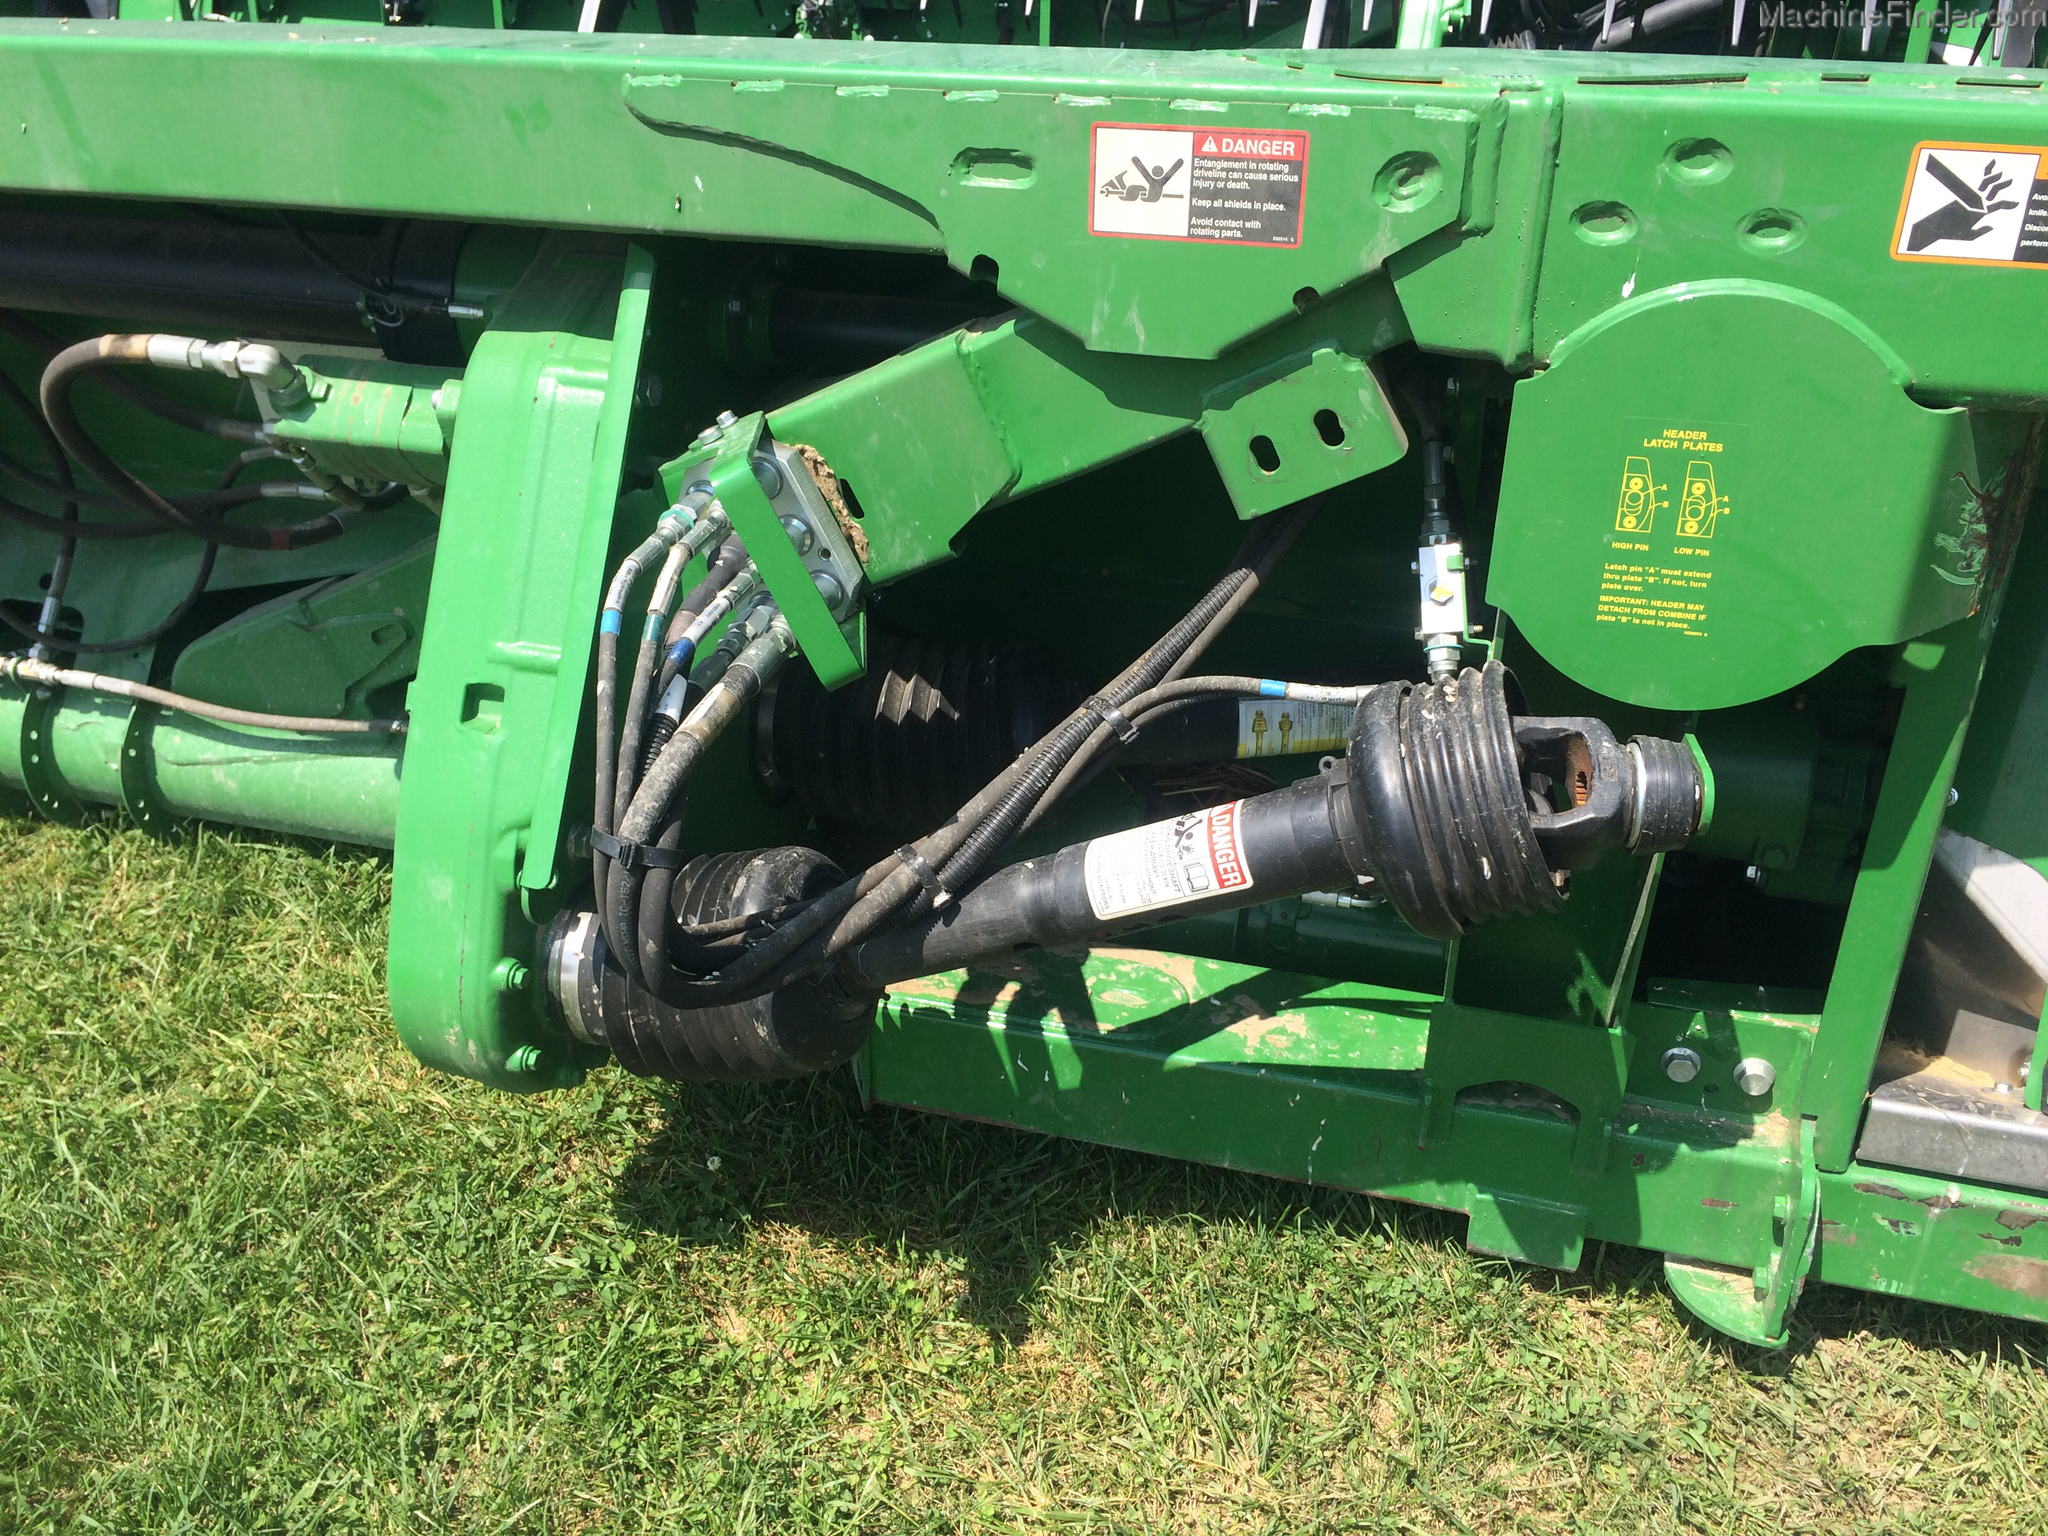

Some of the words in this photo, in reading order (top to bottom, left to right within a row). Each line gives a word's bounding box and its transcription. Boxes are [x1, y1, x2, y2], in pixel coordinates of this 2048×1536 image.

[1222, 138, 1295, 156] DANGER
[1194, 158, 1247, 169] Entanglement
[1249, 161, 1257, 169] in
[1258, 162, 1289, 172] rotating
[1193, 168, 1226, 178] driveline
[1228, 171, 1243, 179] can
[1244, 172, 1267, 180] cause
[1269, 173, 1298, 182] serious
[1193, 179, 1214, 189] injury
[1226, 180, 1250, 189] death.
[2031, 193, 2048, 201] Avo
[1192, 198, 1212, 208] Keep
[1213, 199, 1222, 207] all
[1224, 199, 1252, 209] shields
[1263, 202, 1286, 212] place.
[1191, 217, 1212, 226] Avoid
[1214, 219, 1243, 228] contact
[1245, 219, 1261, 229] with
[1190, 227, 1219, 237] rotating
[1221, 228, 1243, 238] parts.
[1663, 429, 1707, 440] HEADER
[1644, 438, 1678, 449] LATCH
[1683, 441, 1723, 452] PLATES
[1612, 542, 1633, 550] HIGH
[1635, 543, 1649, 551] PIN
[1674, 547, 1693, 555] LOW
[1605, 563, 1627, 572] Latch
[1661, 568, 1681, 576] must
[1684, 570, 1712, 579] extend
[1602, 582, 1622, 591] plate
[1624, 584, 1644, 592] over.
[1603, 572, 1620, 580] thru
[1622, 574, 1643, 583] plate
[1672, 579, 1688, 587] not,
[1690, 580, 1707, 588] turn
[1600, 595, 1649, 605] IMPORTANT:
[1651, 600, 1685, 609] HEADER
[1687, 603, 1705, 611] MAY
[1598, 604, 1631, 614] DETACH
[1632, 607, 1656, 616] FROM
[1658, 609, 1696, 620] COMBINE
[1699, 613, 1706, 621] IF
[1596, 613, 1616, 623] plate
[1667, 620, 1690, 630] place.
[1212, 816, 1241, 887] DANGER
